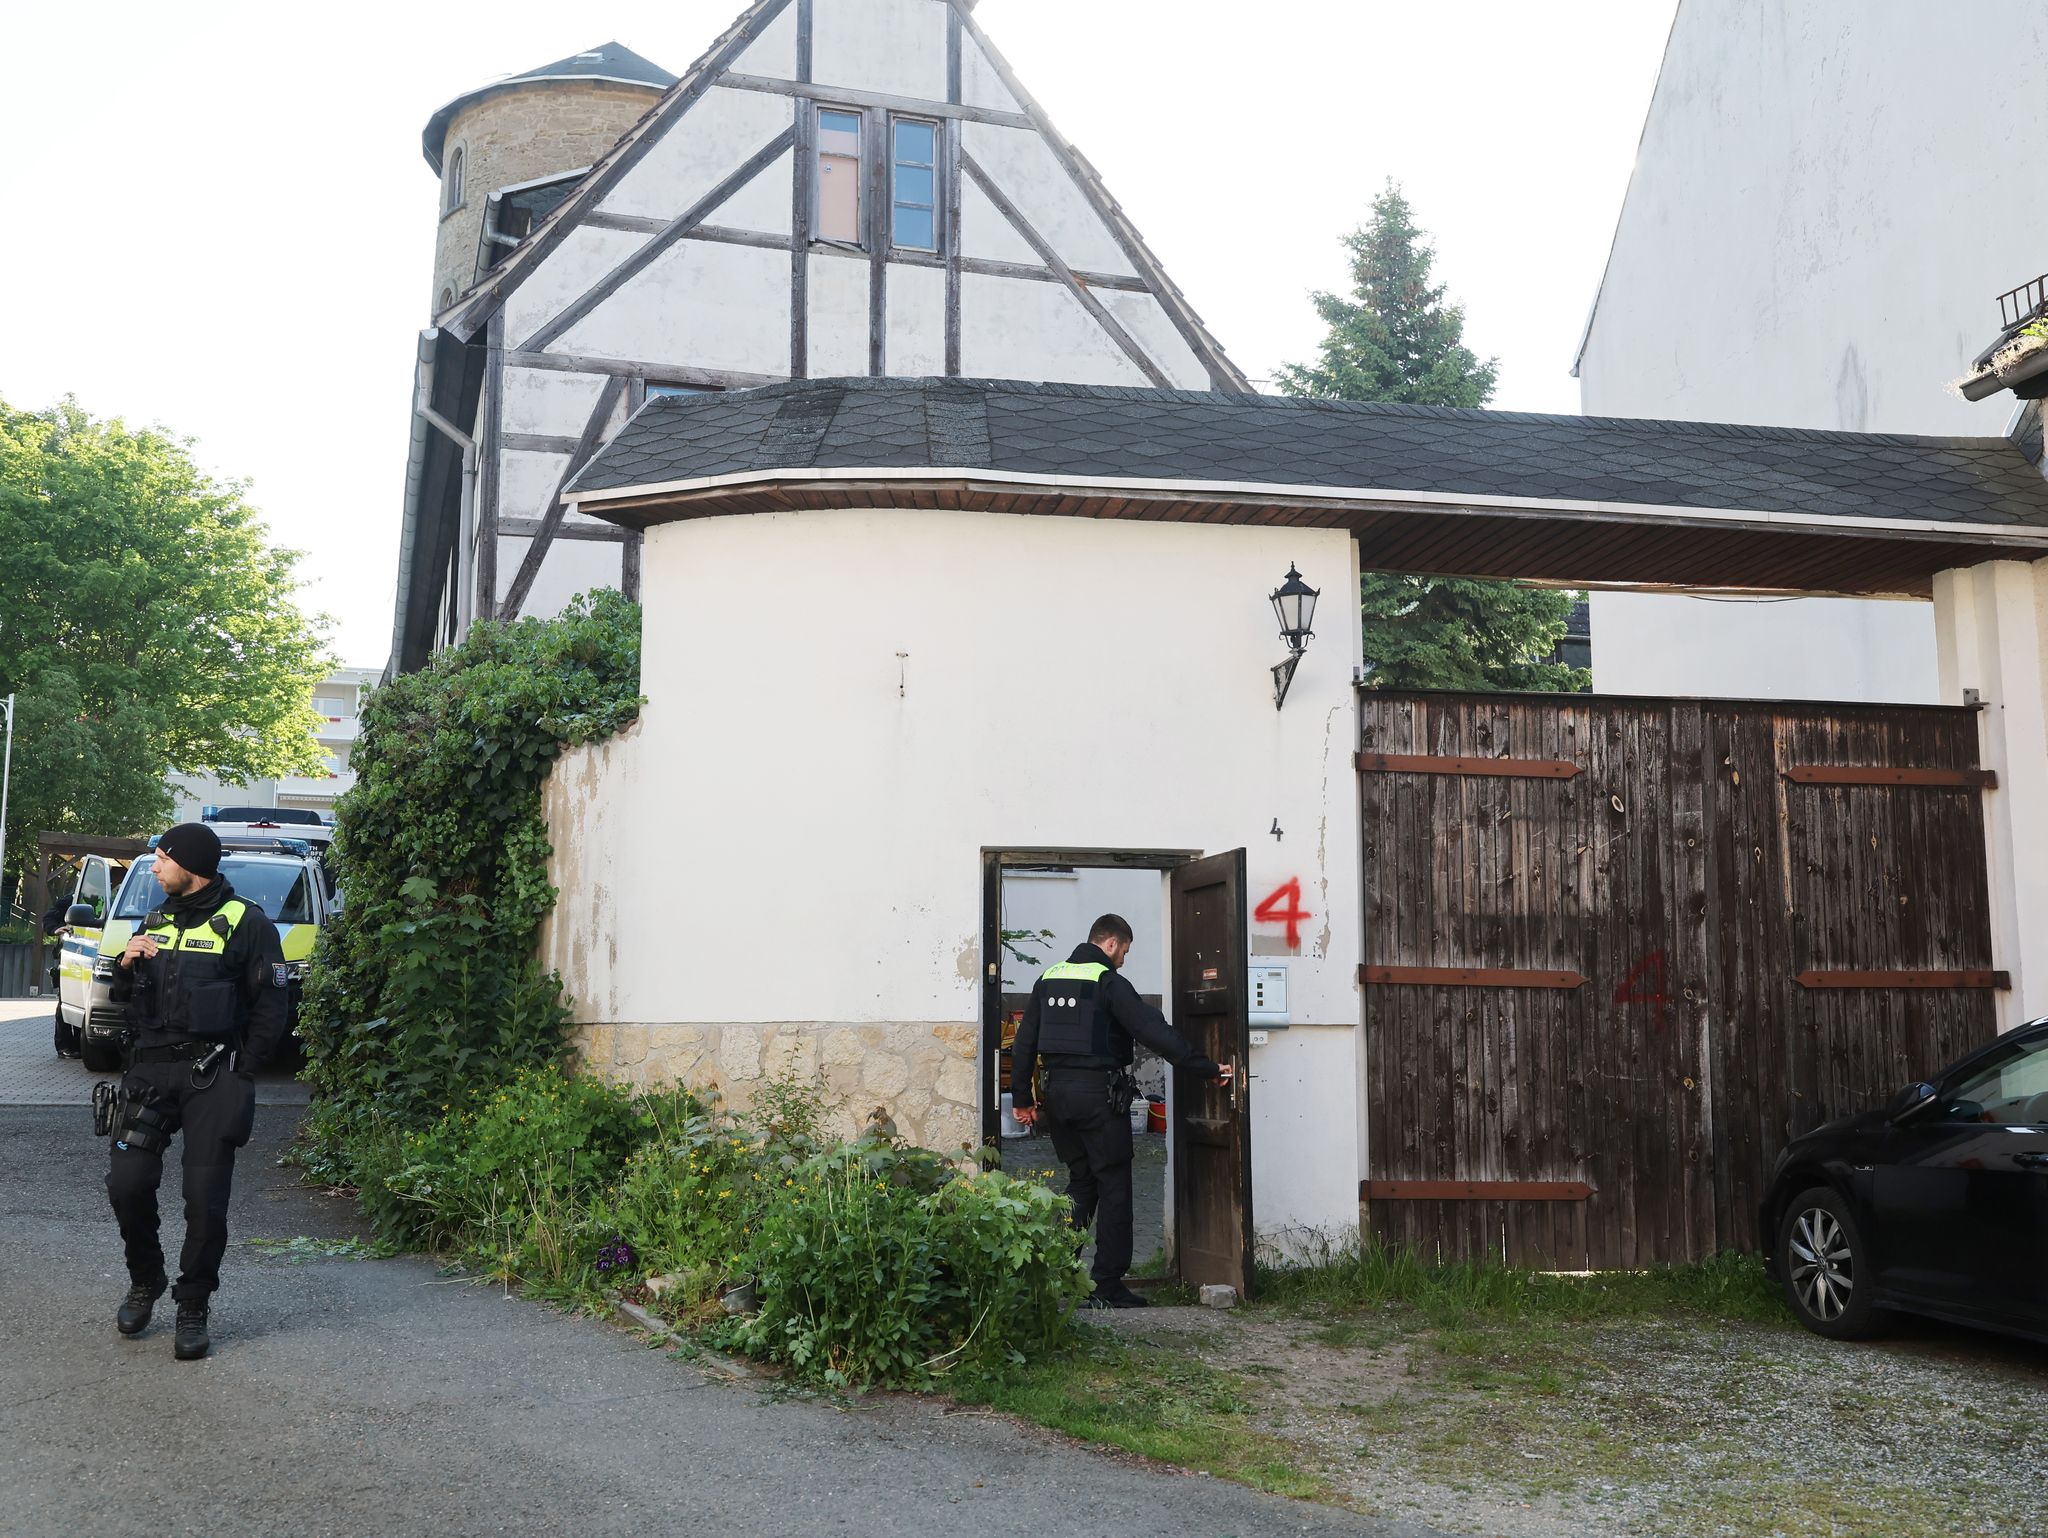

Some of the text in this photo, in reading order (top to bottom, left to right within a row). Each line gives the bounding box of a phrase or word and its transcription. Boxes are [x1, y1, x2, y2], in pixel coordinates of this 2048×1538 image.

[1269, 817, 1284, 842] 4
[1254, 876, 1312, 949] 4
[1615, 949, 1668, 1032] 4
